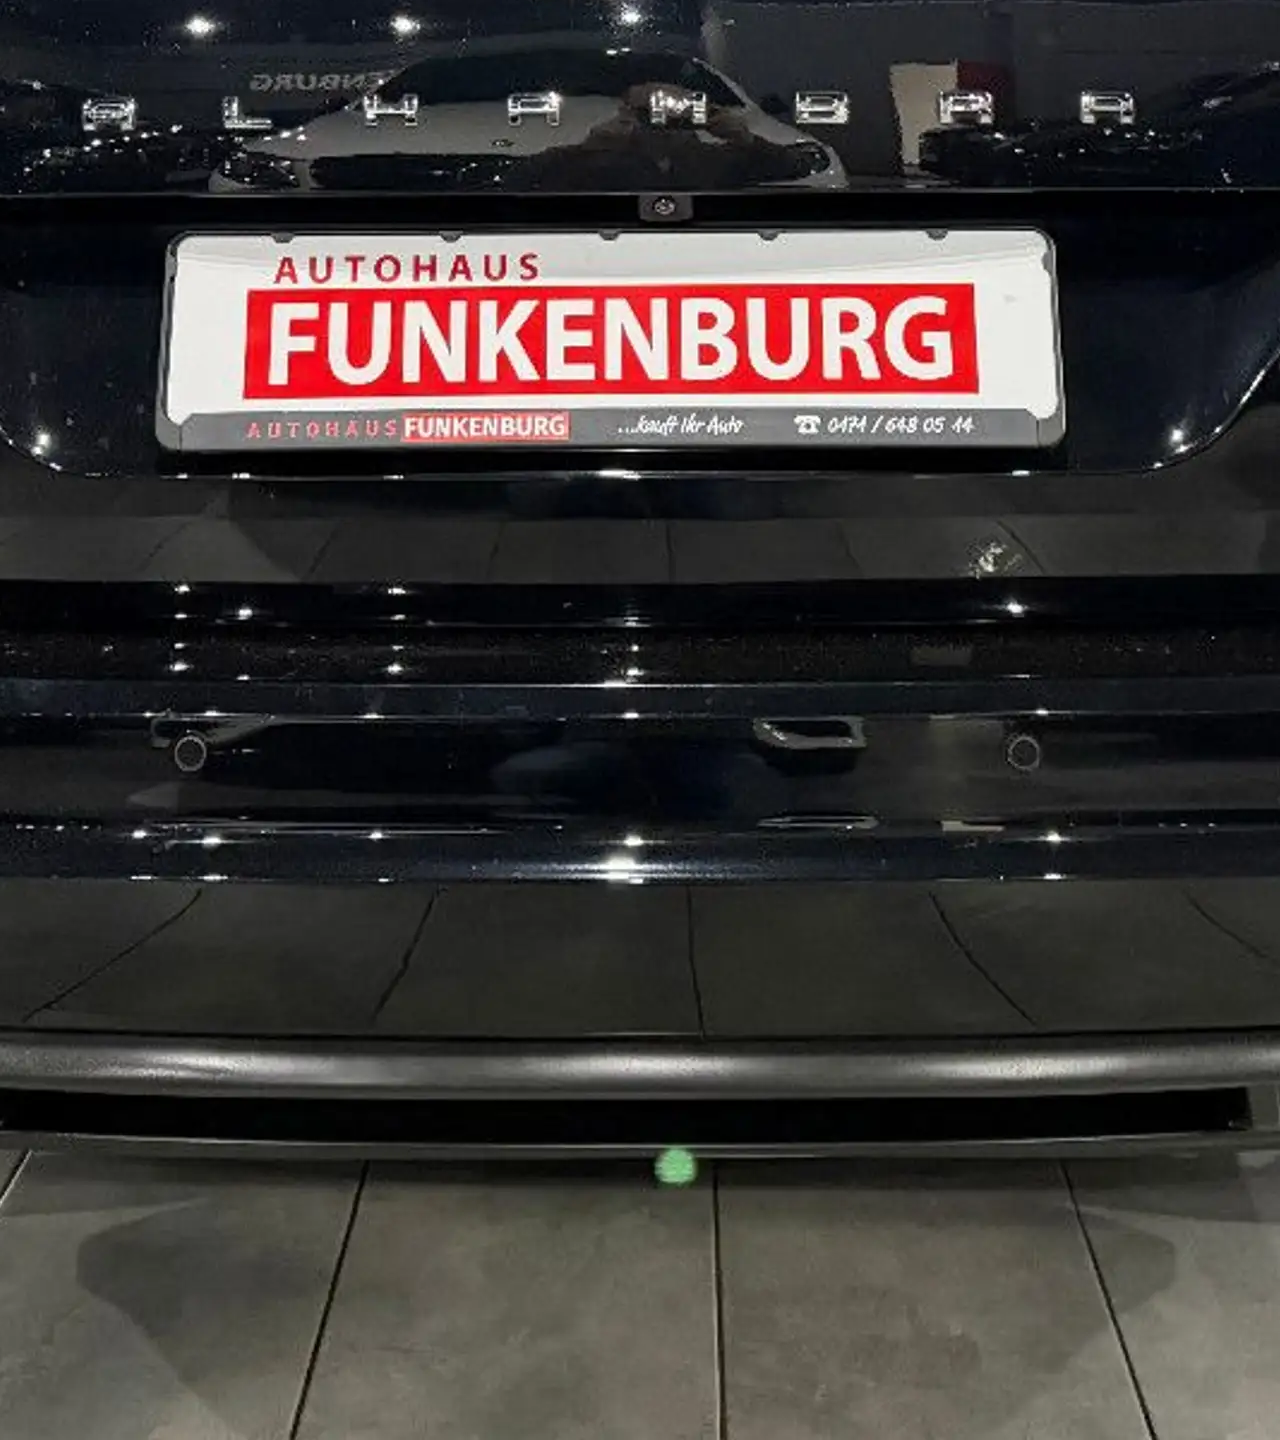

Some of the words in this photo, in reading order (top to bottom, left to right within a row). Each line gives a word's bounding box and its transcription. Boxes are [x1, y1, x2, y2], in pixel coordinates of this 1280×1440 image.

[81, 93, 1134, 131] ALHAMBRA
[274, 252, 540, 284] AUTOHAUS
[267, 296, 955, 387] FUNKENBURG
[246, 418, 398, 439] AUTOHAUS
[404, 414, 566, 438] FUNKENBURG
[706, 415, 745, 436] Auto
[923, 416, 946, 434] 05
